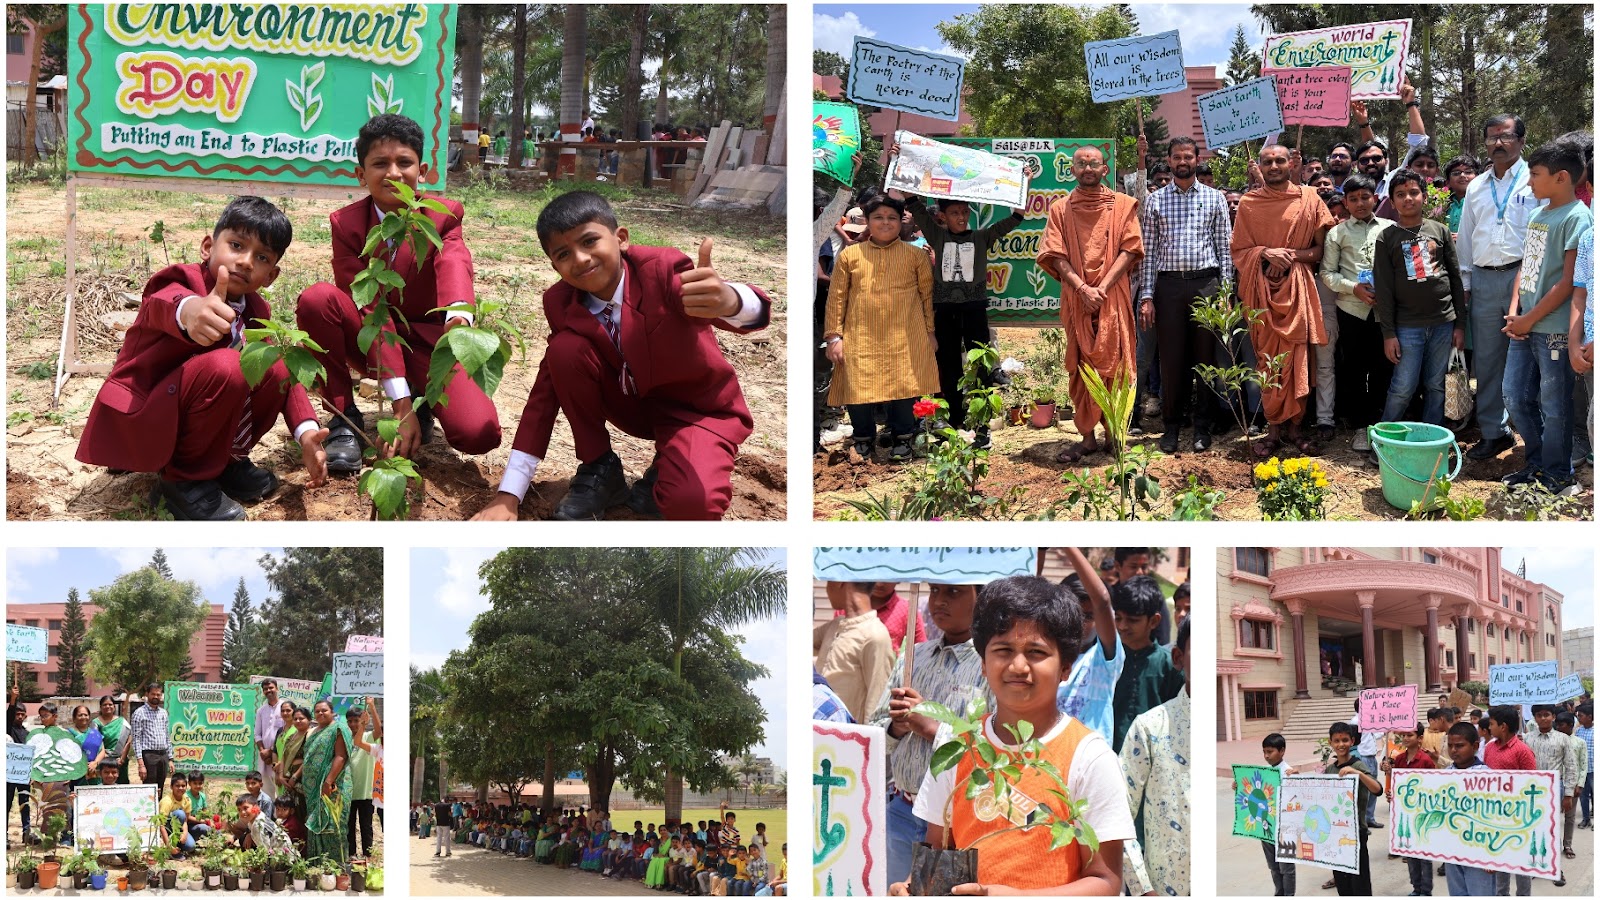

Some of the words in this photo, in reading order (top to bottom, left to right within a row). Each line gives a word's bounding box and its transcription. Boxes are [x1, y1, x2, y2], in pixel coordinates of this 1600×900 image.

[1270, 30, 1397, 66] Environment
[861, 48, 882, 64] The
[887, 55, 922, 73] Poetry
[924, 64, 937, 76] of
[939, 68, 956, 80] the
[1094, 52, 1109, 69] All
[1114, 53, 1134, 65] our
[864, 66, 893, 82] earth
[900, 71, 910, 82] is
[1130, 64, 1142, 74] is
[1128, 76, 1137, 86] in
[1139, 73, 1152, 88] the
[1156, 68, 1180, 82] trees
[1275, 74, 1294, 86] lant
[1296, 76, 1302, 84] a
[1305, 73, 1323, 84] tree
[1328, 74, 1348, 84] even
[128, 61, 244, 110] Day
[876, 84, 914, 96] never
[1208, 96, 1232, 112] Save
[1235, 86, 1262, 103] Earth
[1291, 88, 1299, 97] is
[1232, 108, 1240, 118] to
[1214, 121, 1236, 136] Save
[110, 125, 171, 148] Putting
[174, 134, 196, 148] an
[201, 130, 233, 150] End
[241, 134, 256, 153] to
[262, 137, 318, 155] Plastic
[995, 140, 1052, 152] SGIS@BLR
[1006, 299, 1012, 307] to
[1016, 298, 1044, 308] Plastic
[338, 659, 352, 670] The
[355, 660, 380, 670] Poetry
[341, 670, 360, 679] earth
[1494, 672, 1505, 684] All
[1508, 674, 1524, 682] our
[179, 689, 224, 702] Welcome
[232, 693, 241, 702] to
[1396, 690, 1407, 698] not
[1524, 688, 1534, 699] the
[1536, 686, 1555, 696] trees
[1370, 701, 1378, 710] A
[209, 712, 243, 722] World
[1378, 712, 1386, 722] is
[174, 726, 249, 742] Environment
[175, 748, 204, 759] Day
[1398, 778, 1542, 825] Environment
[1462, 821, 1522, 852] day
